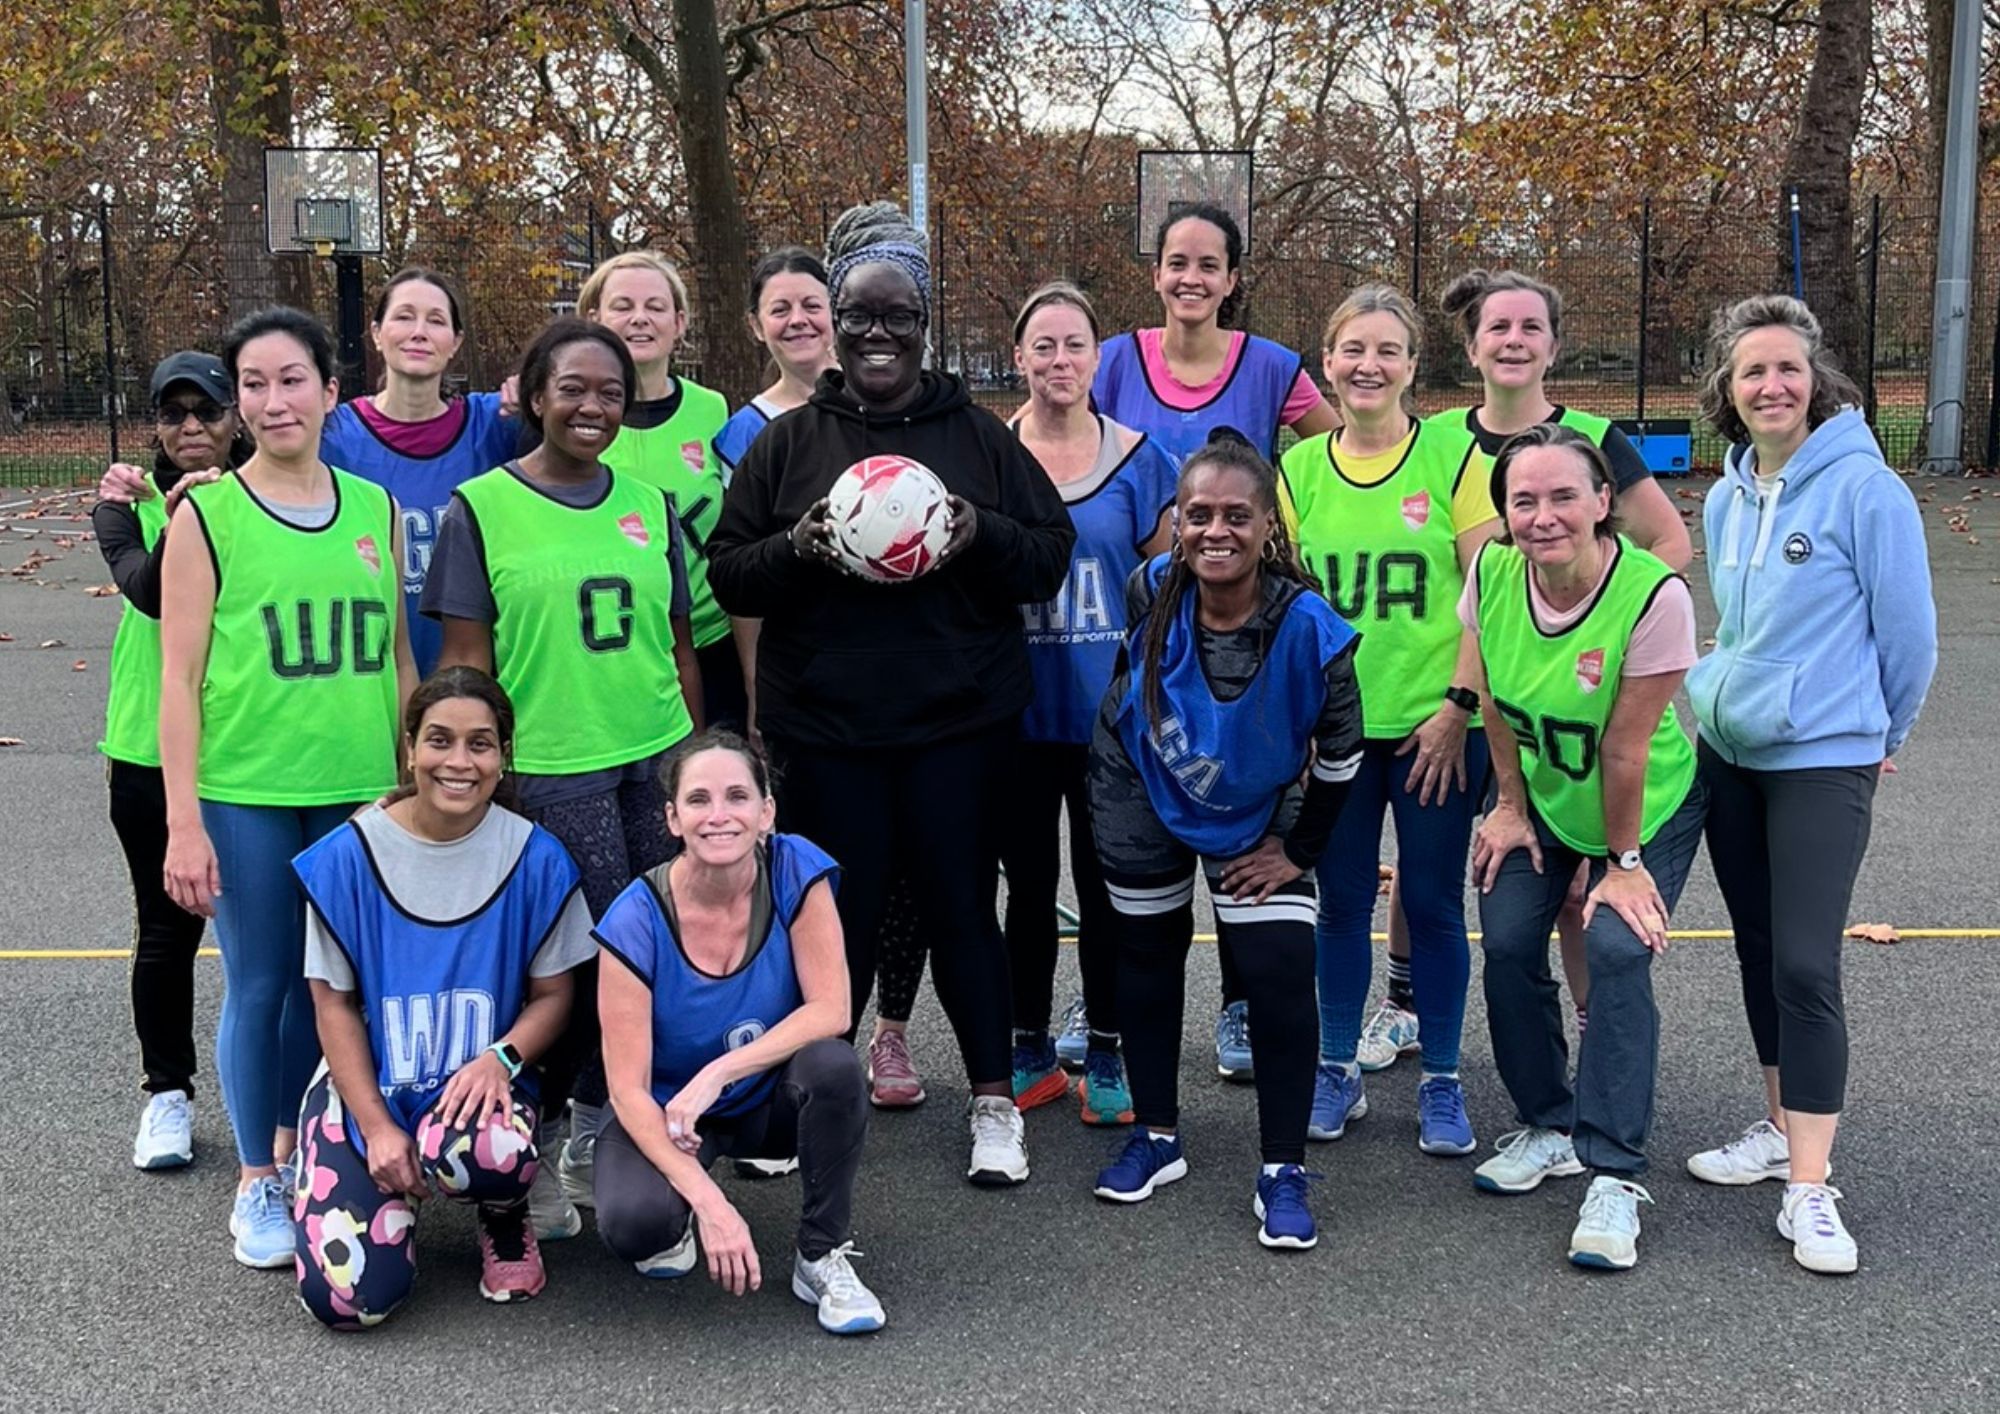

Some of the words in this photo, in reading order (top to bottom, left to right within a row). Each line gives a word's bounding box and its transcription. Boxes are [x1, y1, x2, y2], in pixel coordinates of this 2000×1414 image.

[402, 507, 449, 583] G
[578, 573, 634, 653] C
[382, 987, 495, 1084] WD
